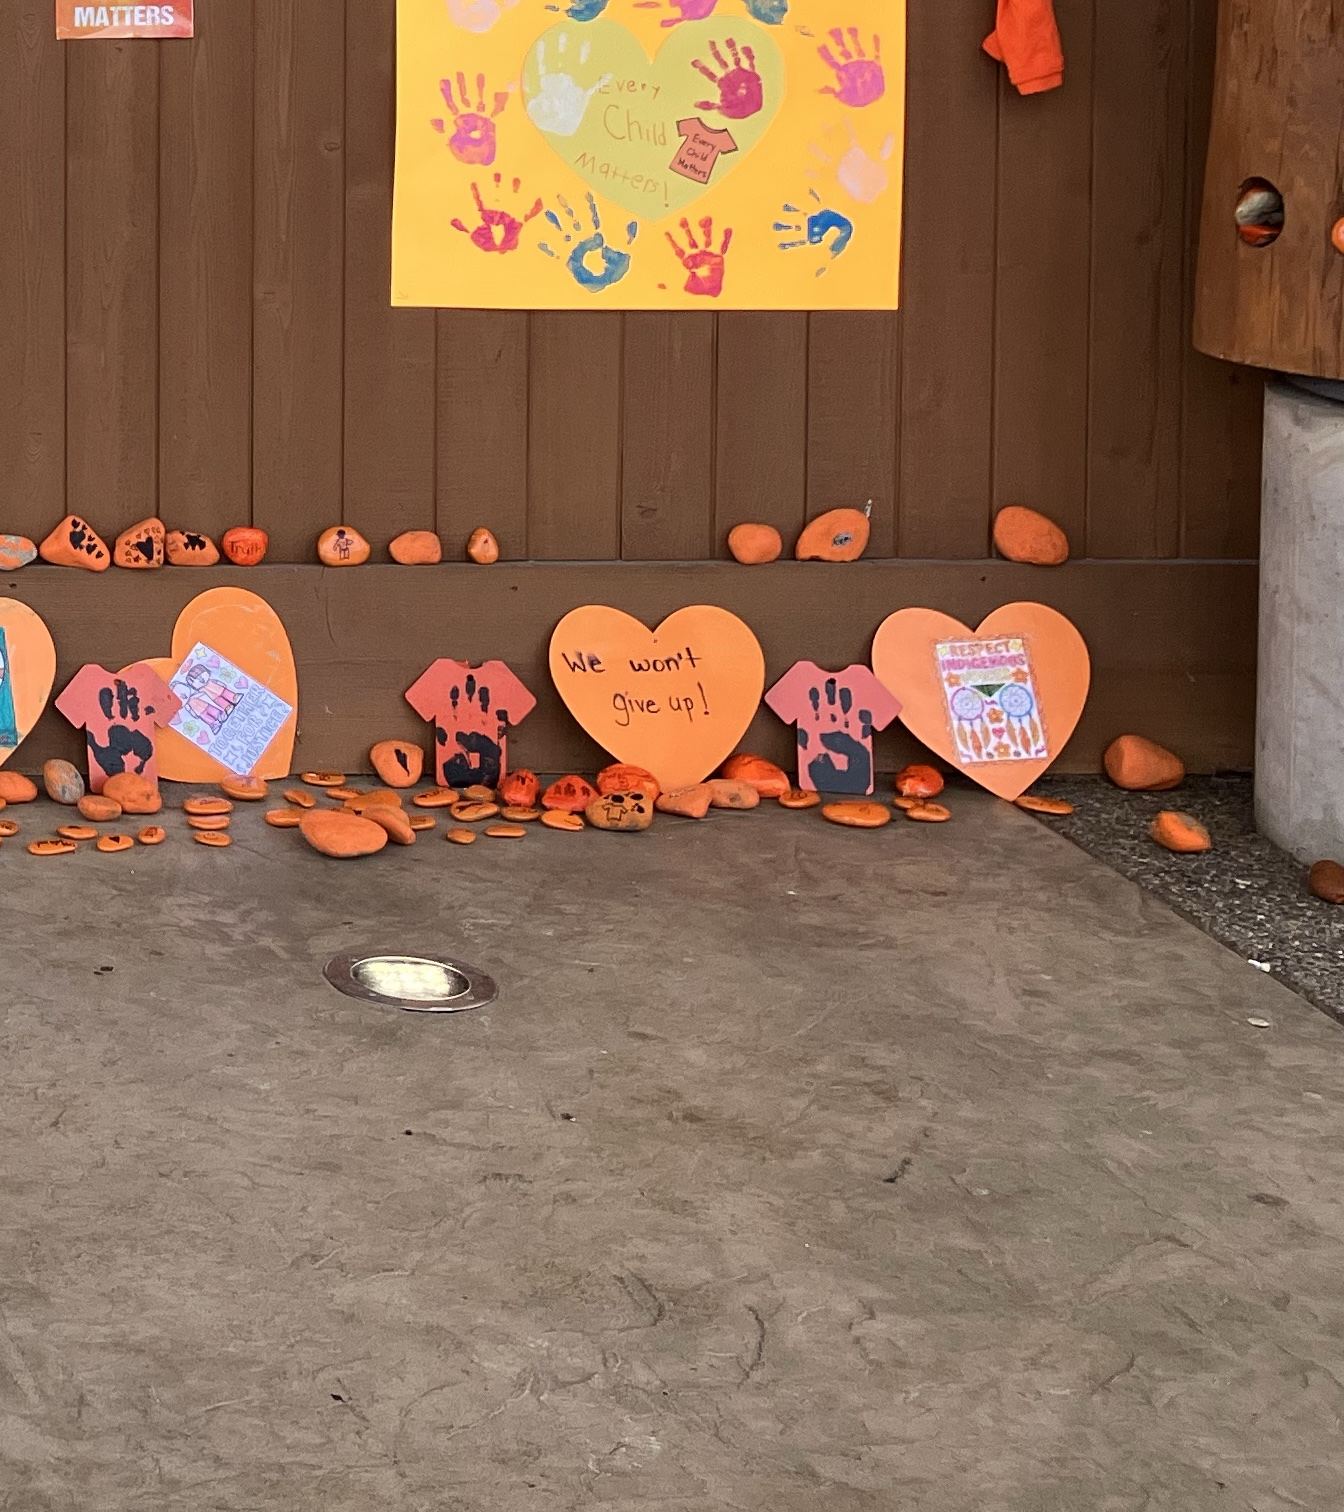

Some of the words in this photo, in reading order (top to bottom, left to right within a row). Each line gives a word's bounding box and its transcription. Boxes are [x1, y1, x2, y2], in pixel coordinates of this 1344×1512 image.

[73, 5, 175, 28] MATTERS
[599, 74, 662, 99] Every
[603, 104, 667, 147] Child
[562, 650, 605, 673] We
[629, 647, 703, 673] won't
[949, 640, 1010, 657] RESPECT
[613, 690, 661, 727] give
[668, 681, 710, 724] up!
[208, 684, 266, 757] TOGETHER
[236, 714, 264, 746] FOR
[241, 708, 286, 768] JUSTICE
